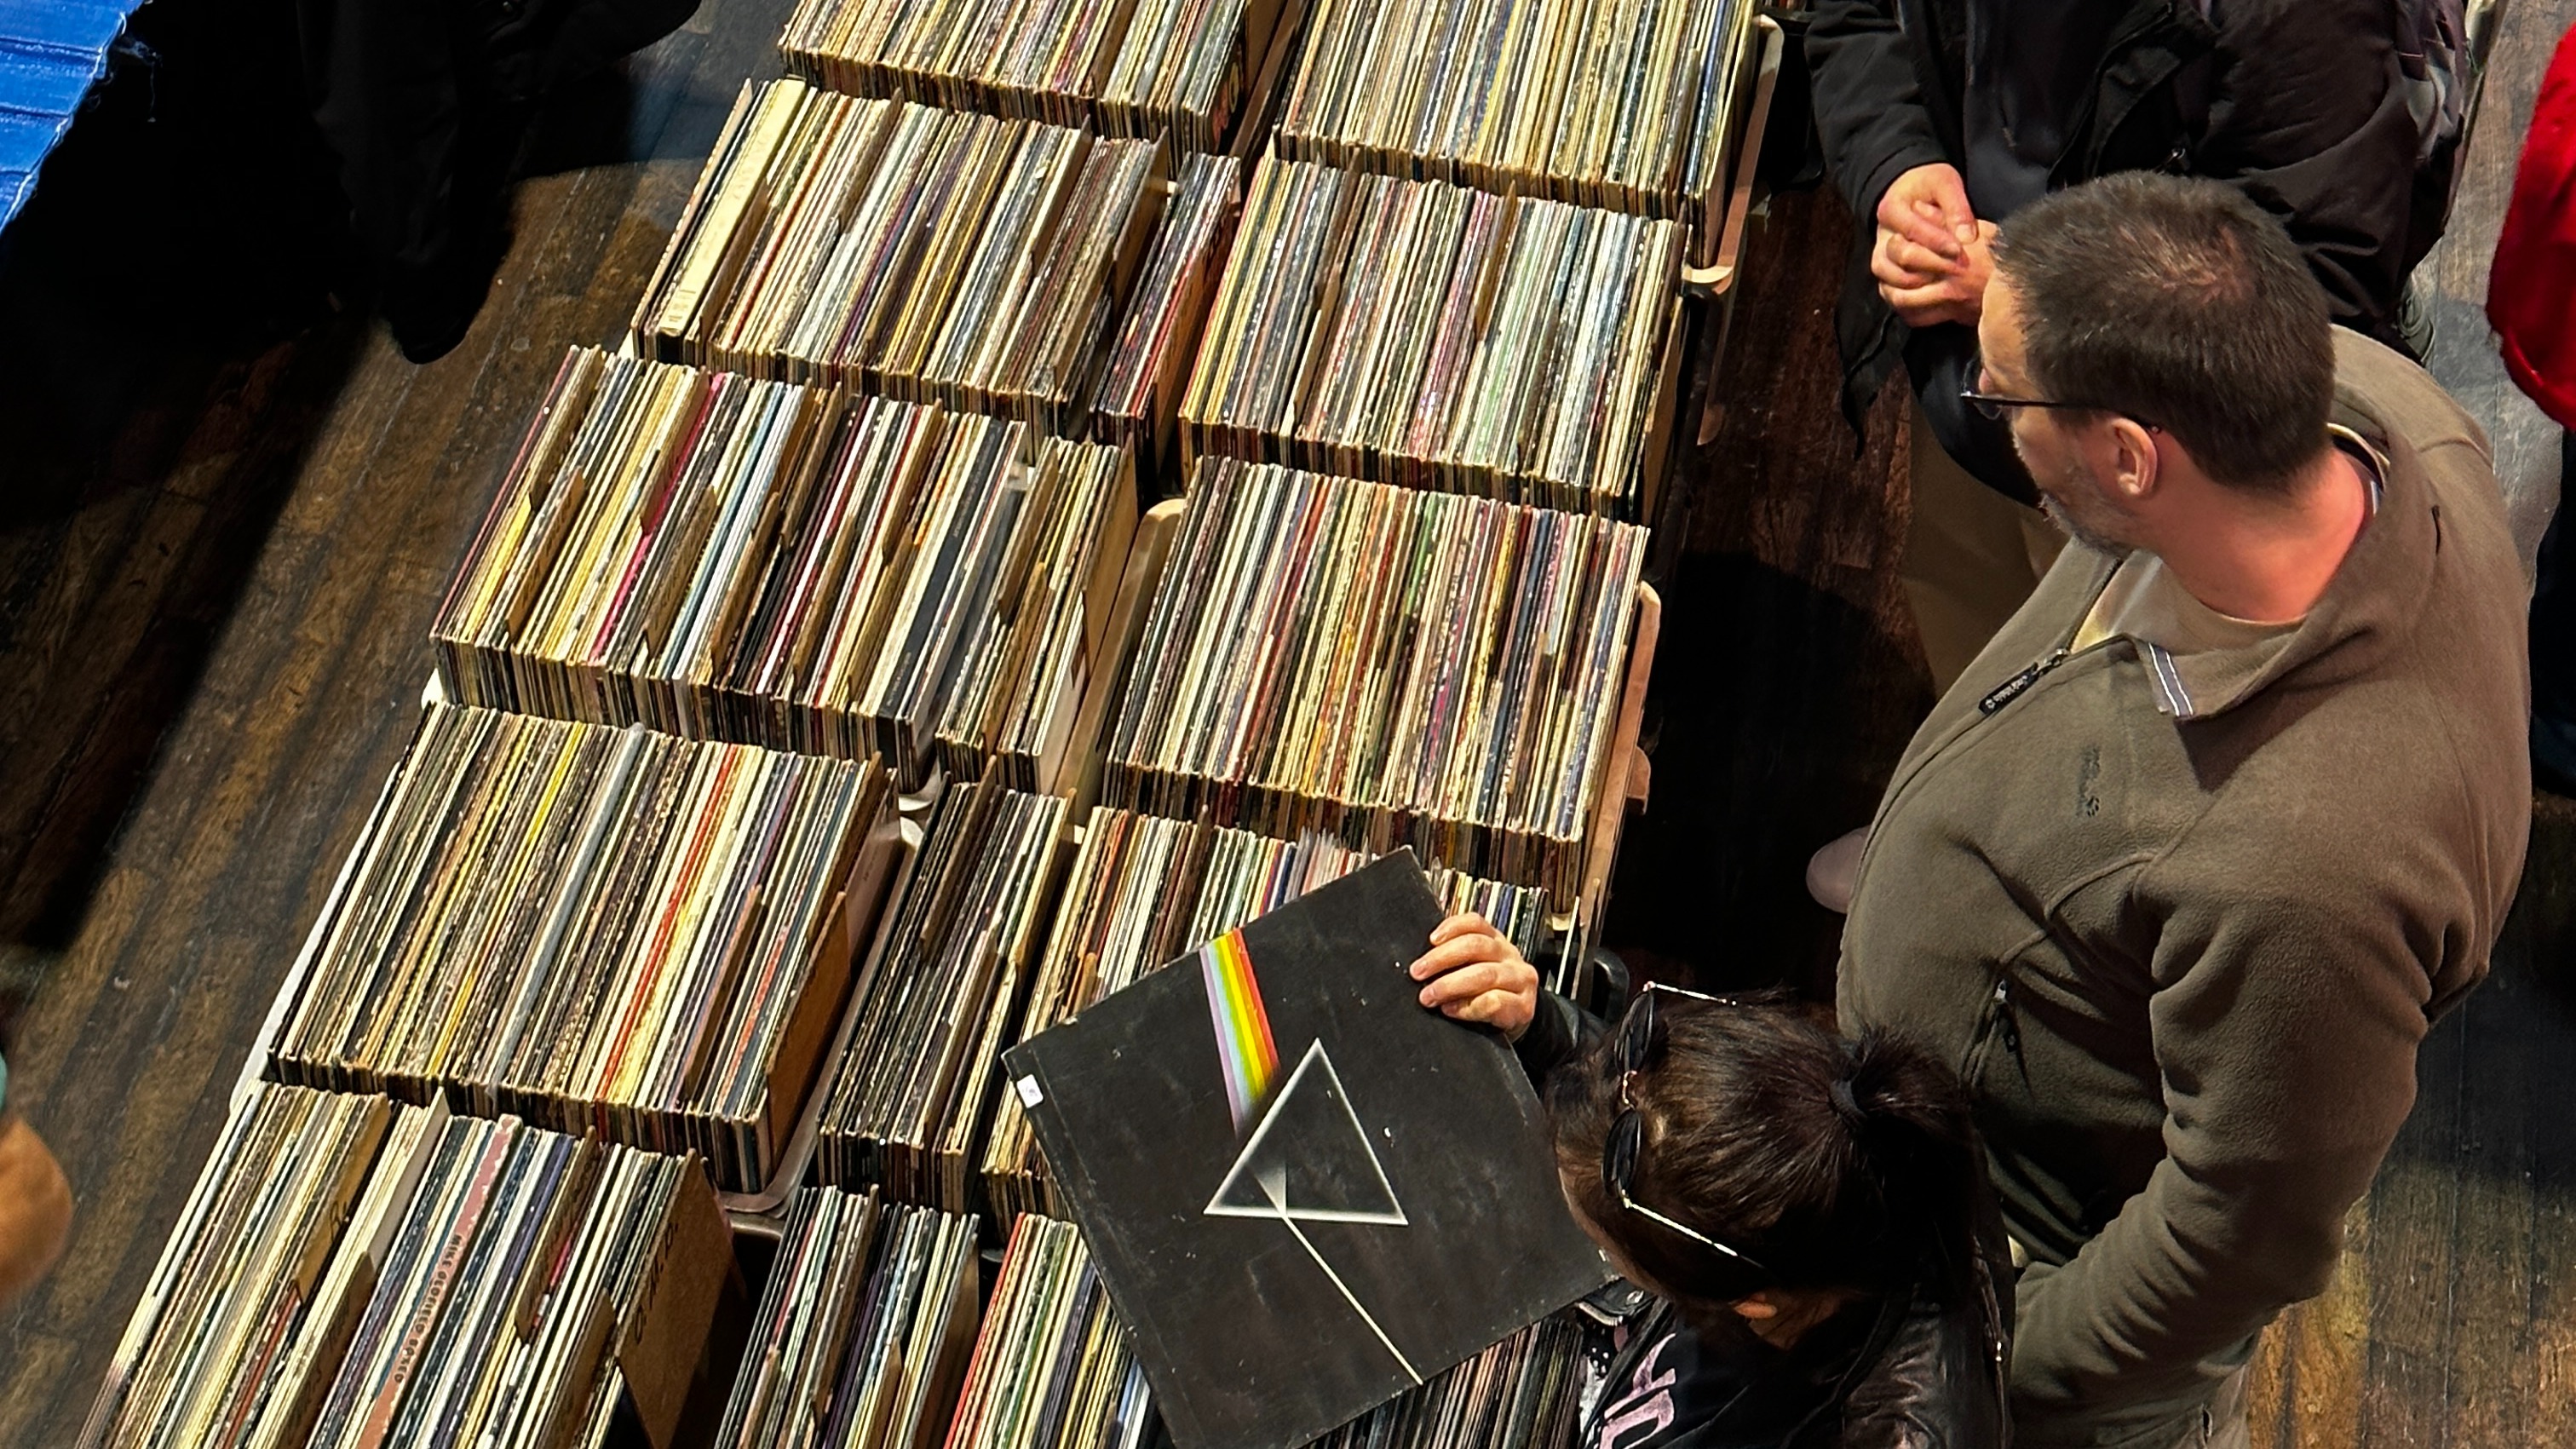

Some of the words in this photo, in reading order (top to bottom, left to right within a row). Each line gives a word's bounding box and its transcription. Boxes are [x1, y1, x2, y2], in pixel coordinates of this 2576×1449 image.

[441, 1233, 463, 1268] MIKE
[415, 1270, 447, 1335] OLDFIELD
[394, 1338, 418, 1384] BOXED
